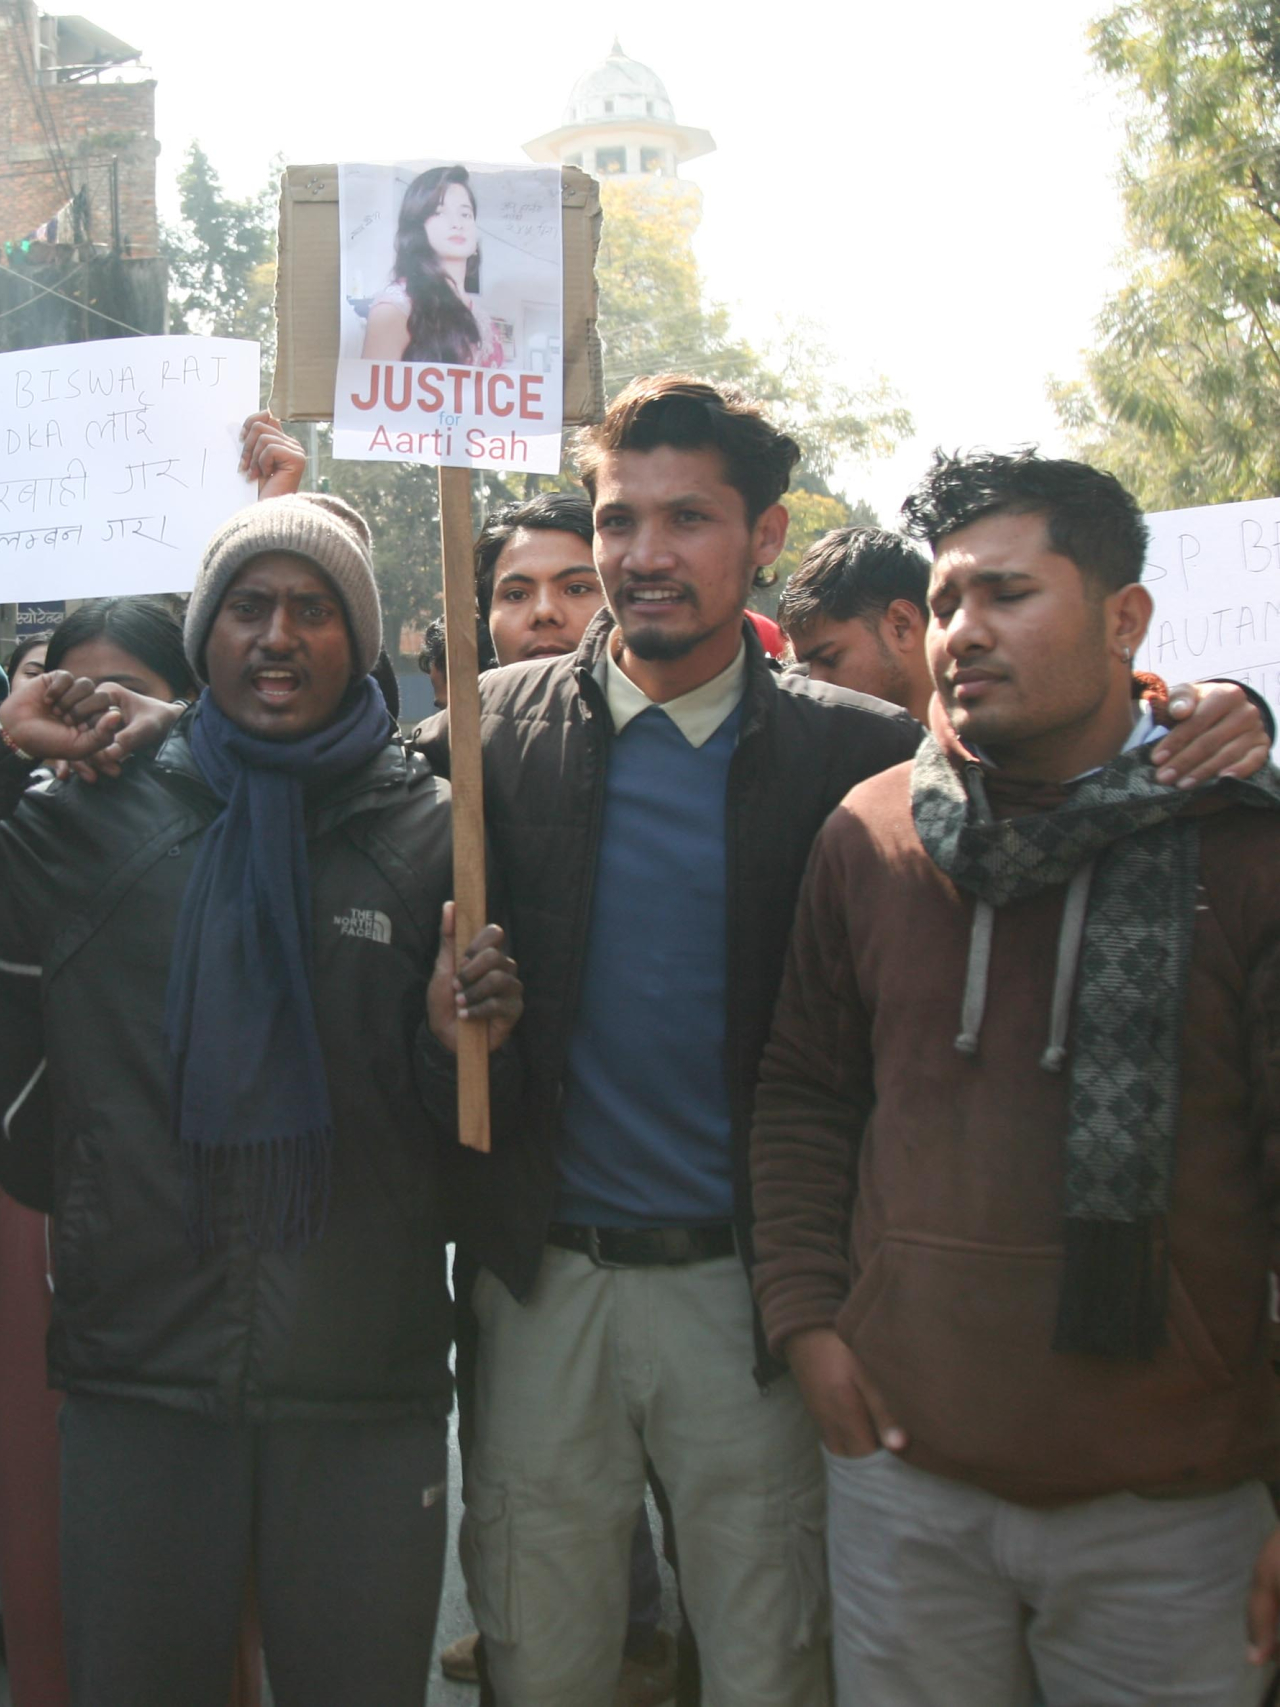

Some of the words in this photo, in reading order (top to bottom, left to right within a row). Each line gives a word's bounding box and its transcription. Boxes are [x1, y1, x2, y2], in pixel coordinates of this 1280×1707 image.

[15, 365, 136, 409] BISWA
[160, 354, 228, 390] RAJ
[350, 364, 545, 421] JUSTICE
[438, 410, 462, 427] for
[368, 424, 453, 457] Aarti
[464, 428, 528, 463] Sah
[333, 914, 374, 930] NORTH
[350, 908, 374, 920] THE
[340, 926, 373, 939] FACE
